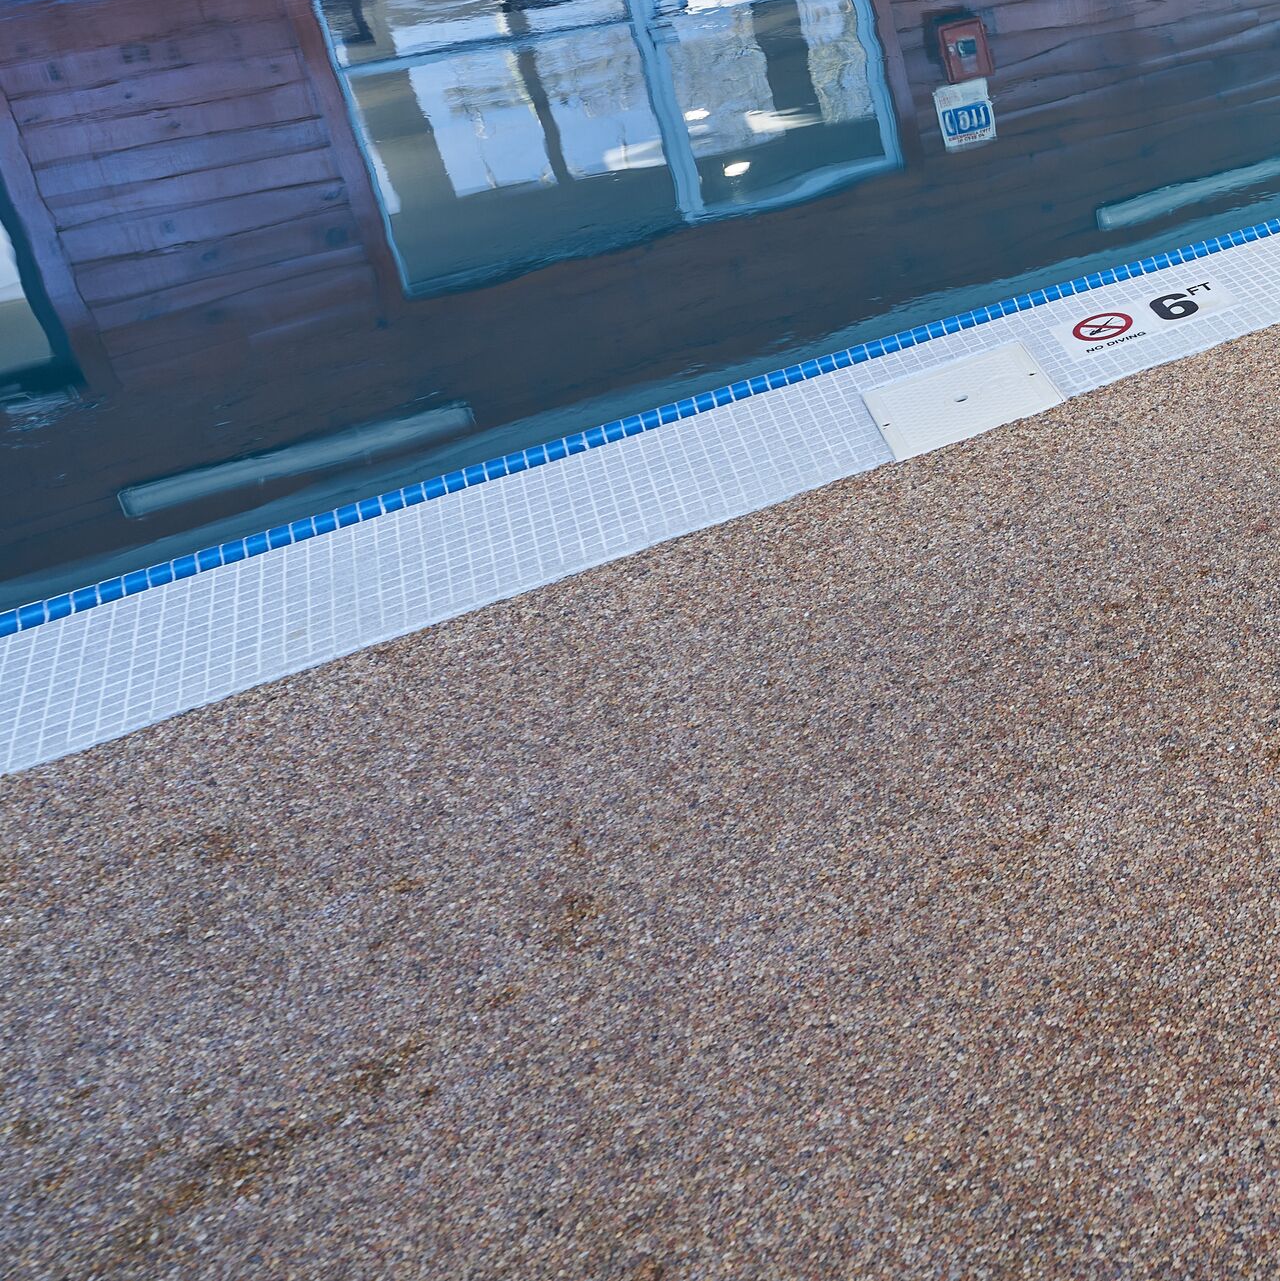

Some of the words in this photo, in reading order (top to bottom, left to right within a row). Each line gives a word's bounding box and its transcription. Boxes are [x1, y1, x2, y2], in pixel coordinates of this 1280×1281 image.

[1149, 293, 1200, 321] 6
[1186, 281, 1212, 296] FT
[1086, 345, 1104, 354] NO
[1106, 331, 1147, 347] DIVING
